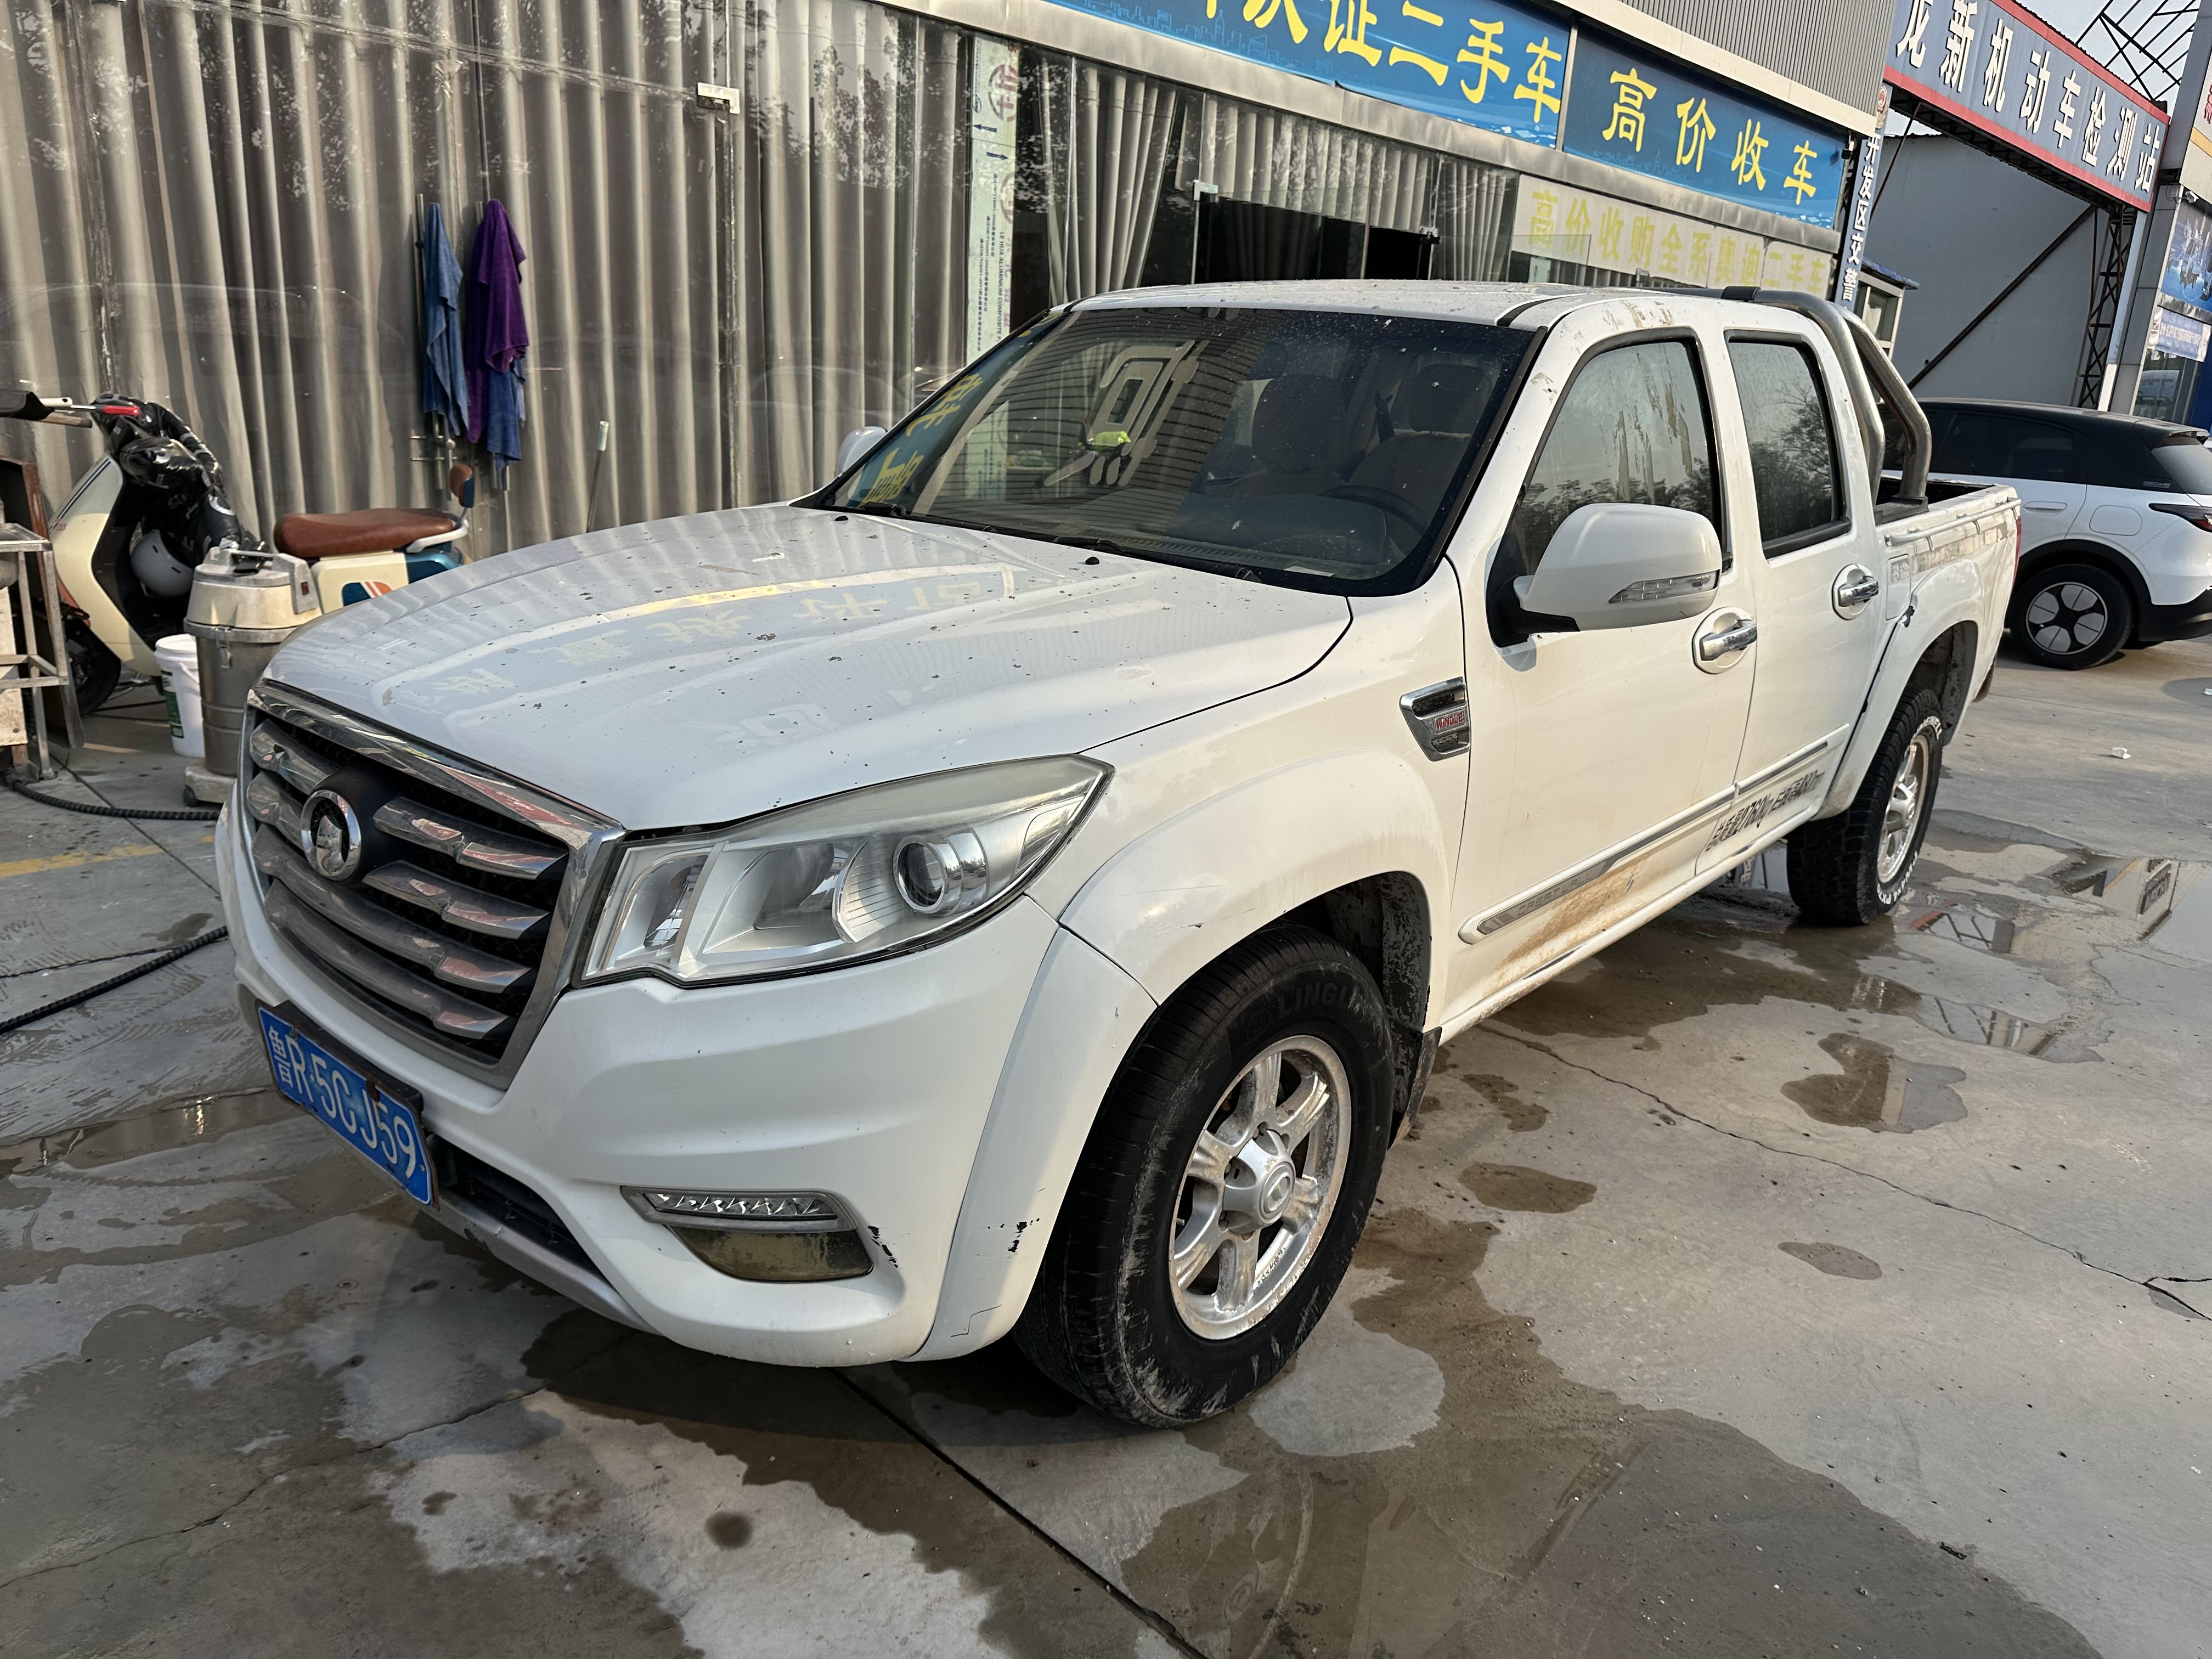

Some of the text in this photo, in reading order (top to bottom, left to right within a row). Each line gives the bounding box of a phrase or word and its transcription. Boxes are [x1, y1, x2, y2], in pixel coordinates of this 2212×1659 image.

[1602, 67, 1818, 205] 高价收车
[1528, 188, 1827, 294] 高价收购全系奥迪二手车
[1842, 133, 1881, 302] 开发区交警
[1436, 711, 1464, 730] WINGLE
